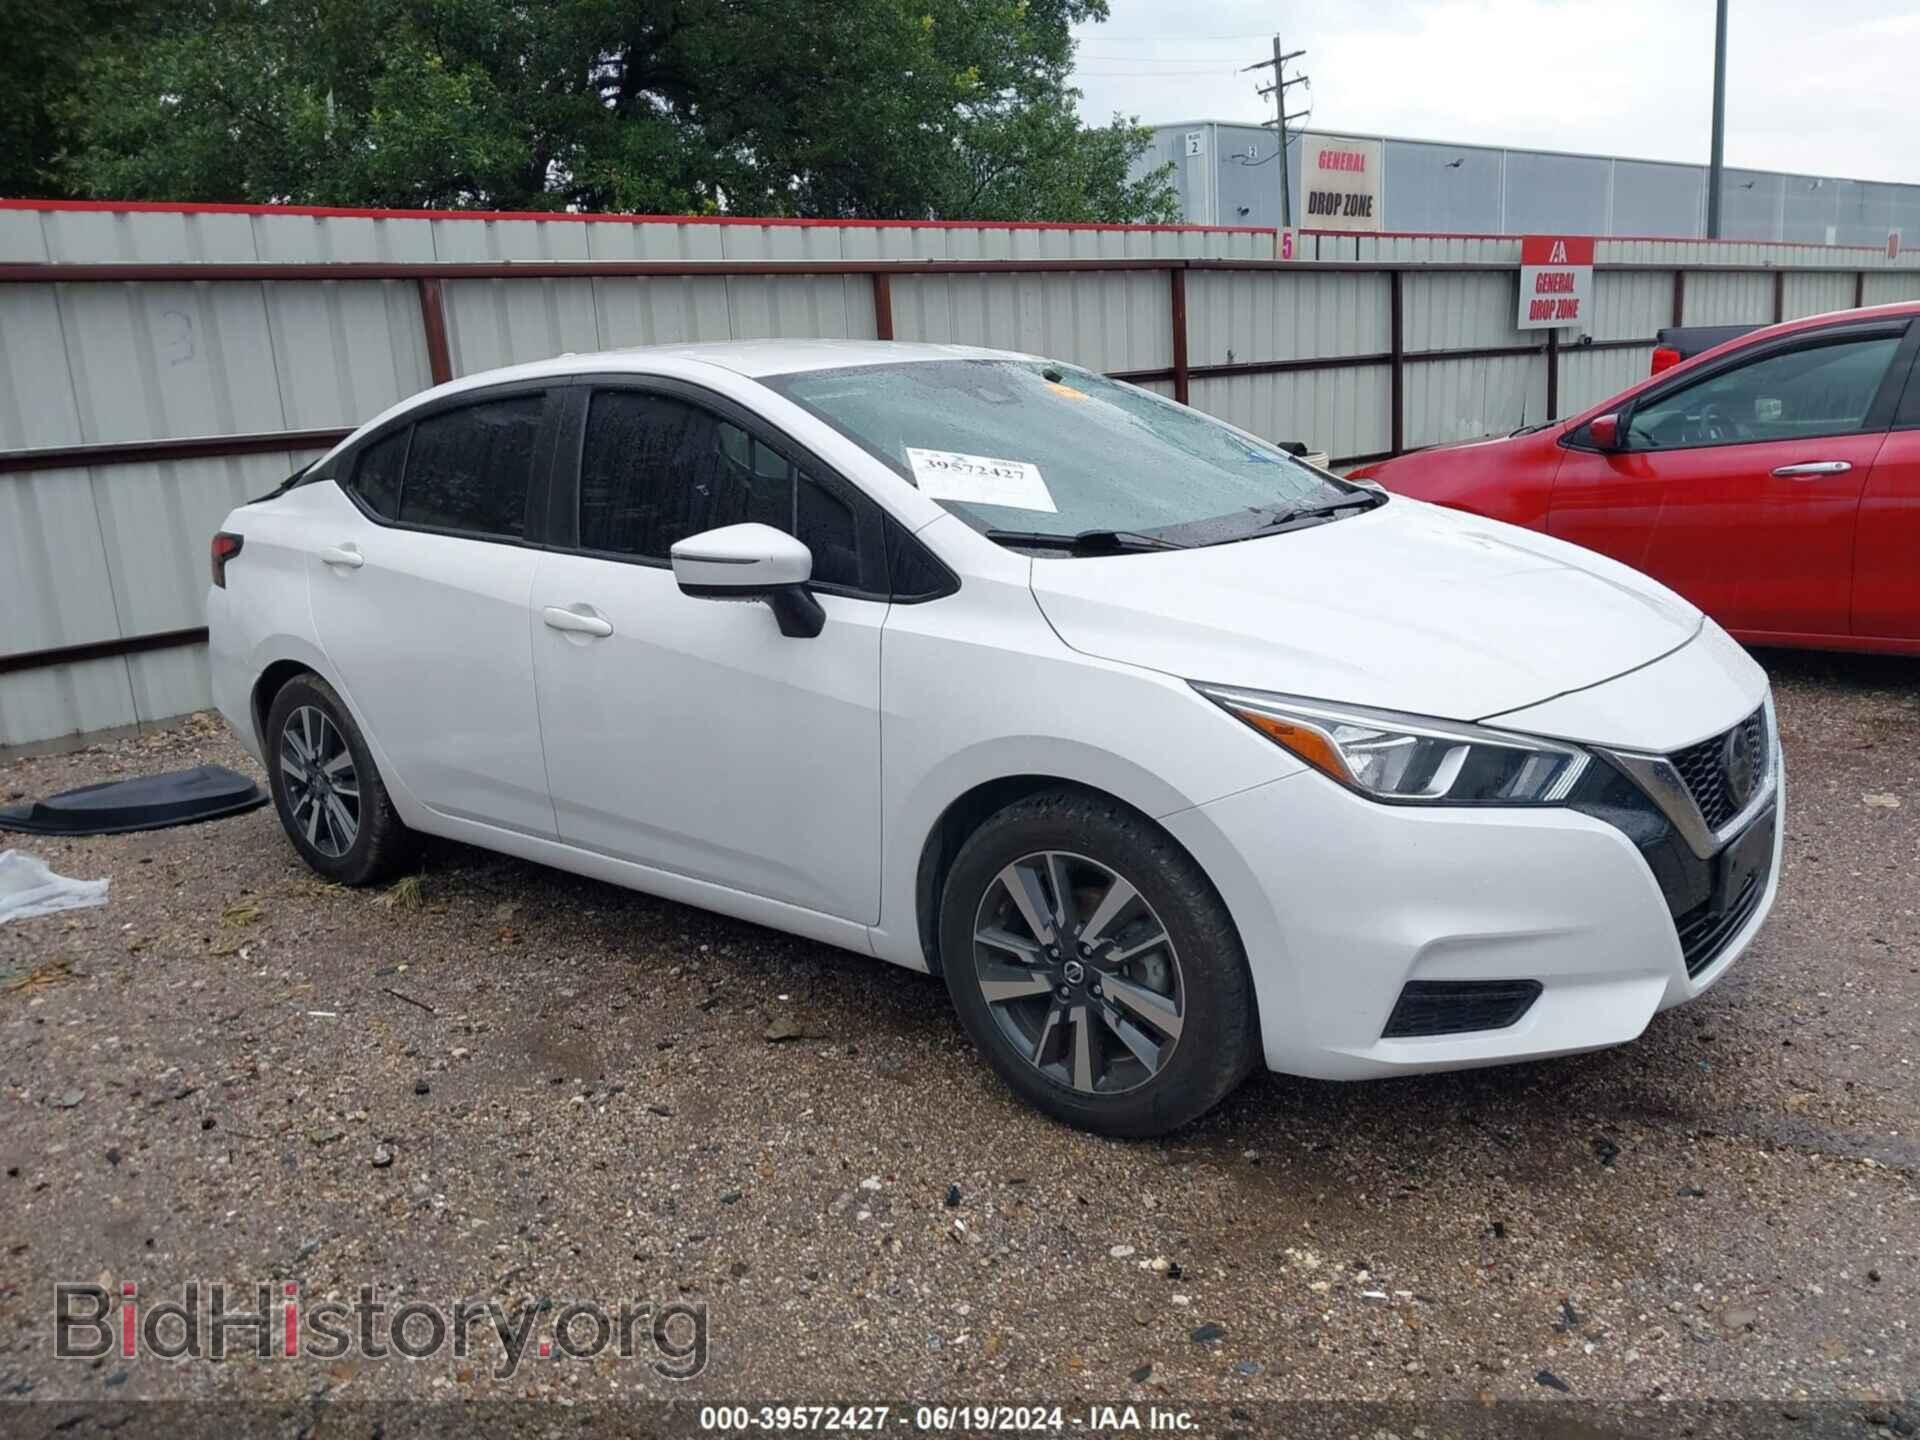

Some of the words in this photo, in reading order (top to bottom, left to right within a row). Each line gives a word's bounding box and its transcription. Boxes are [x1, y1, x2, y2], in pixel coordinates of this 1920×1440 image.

[1191, 141, 1198, 153] 2
[1318, 150, 1365, 172] GENERAL
[1308, 191, 1342, 216] DROP
[1343, 193, 1373, 217] ZONE
[1282, 232, 1292, 260] 5
[1535, 272, 1575, 294] GENERAL
[1529, 298, 1556, 321] DROP
[1556, 298, 1580, 320] ZONE
[926, 458, 1024, 480] 39572427
